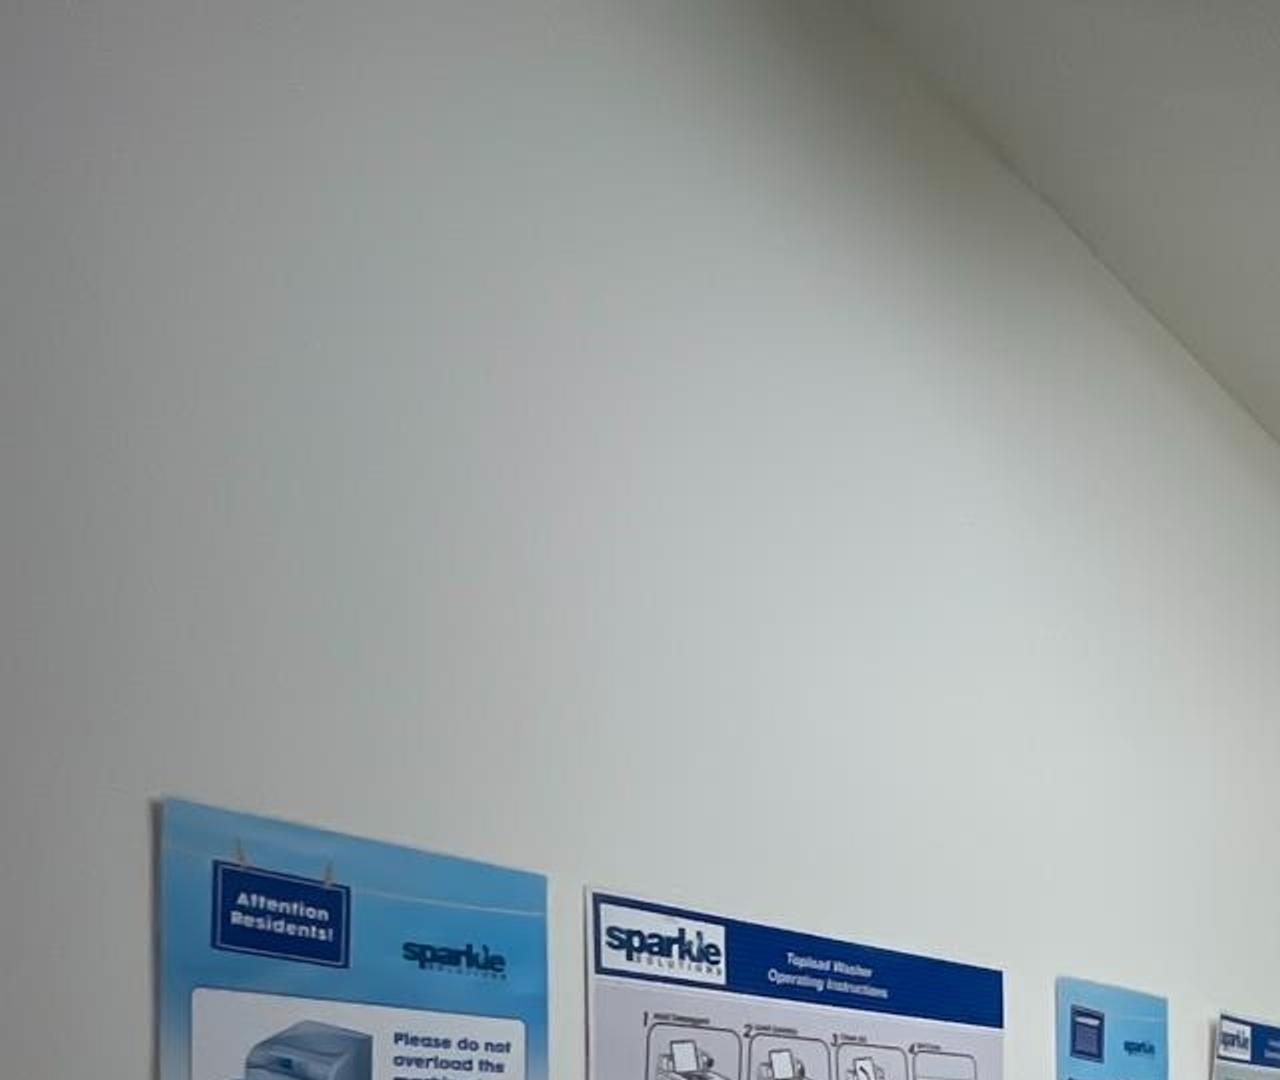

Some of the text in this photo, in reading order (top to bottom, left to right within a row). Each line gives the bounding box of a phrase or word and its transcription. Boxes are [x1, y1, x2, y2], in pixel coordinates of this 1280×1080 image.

[236, 892, 330, 922] Attention
[230, 910, 334, 942] Residents!
[402, 942, 506, 973] sparkle
[605, 926, 722, 965] sparkle
[768, 968, 889, 998] Operating Instructions
[393, 1032, 511, 1053] Please do not
[743, 1024, 753, 1039] 2
[393, 1055, 505, 1073] overload the
